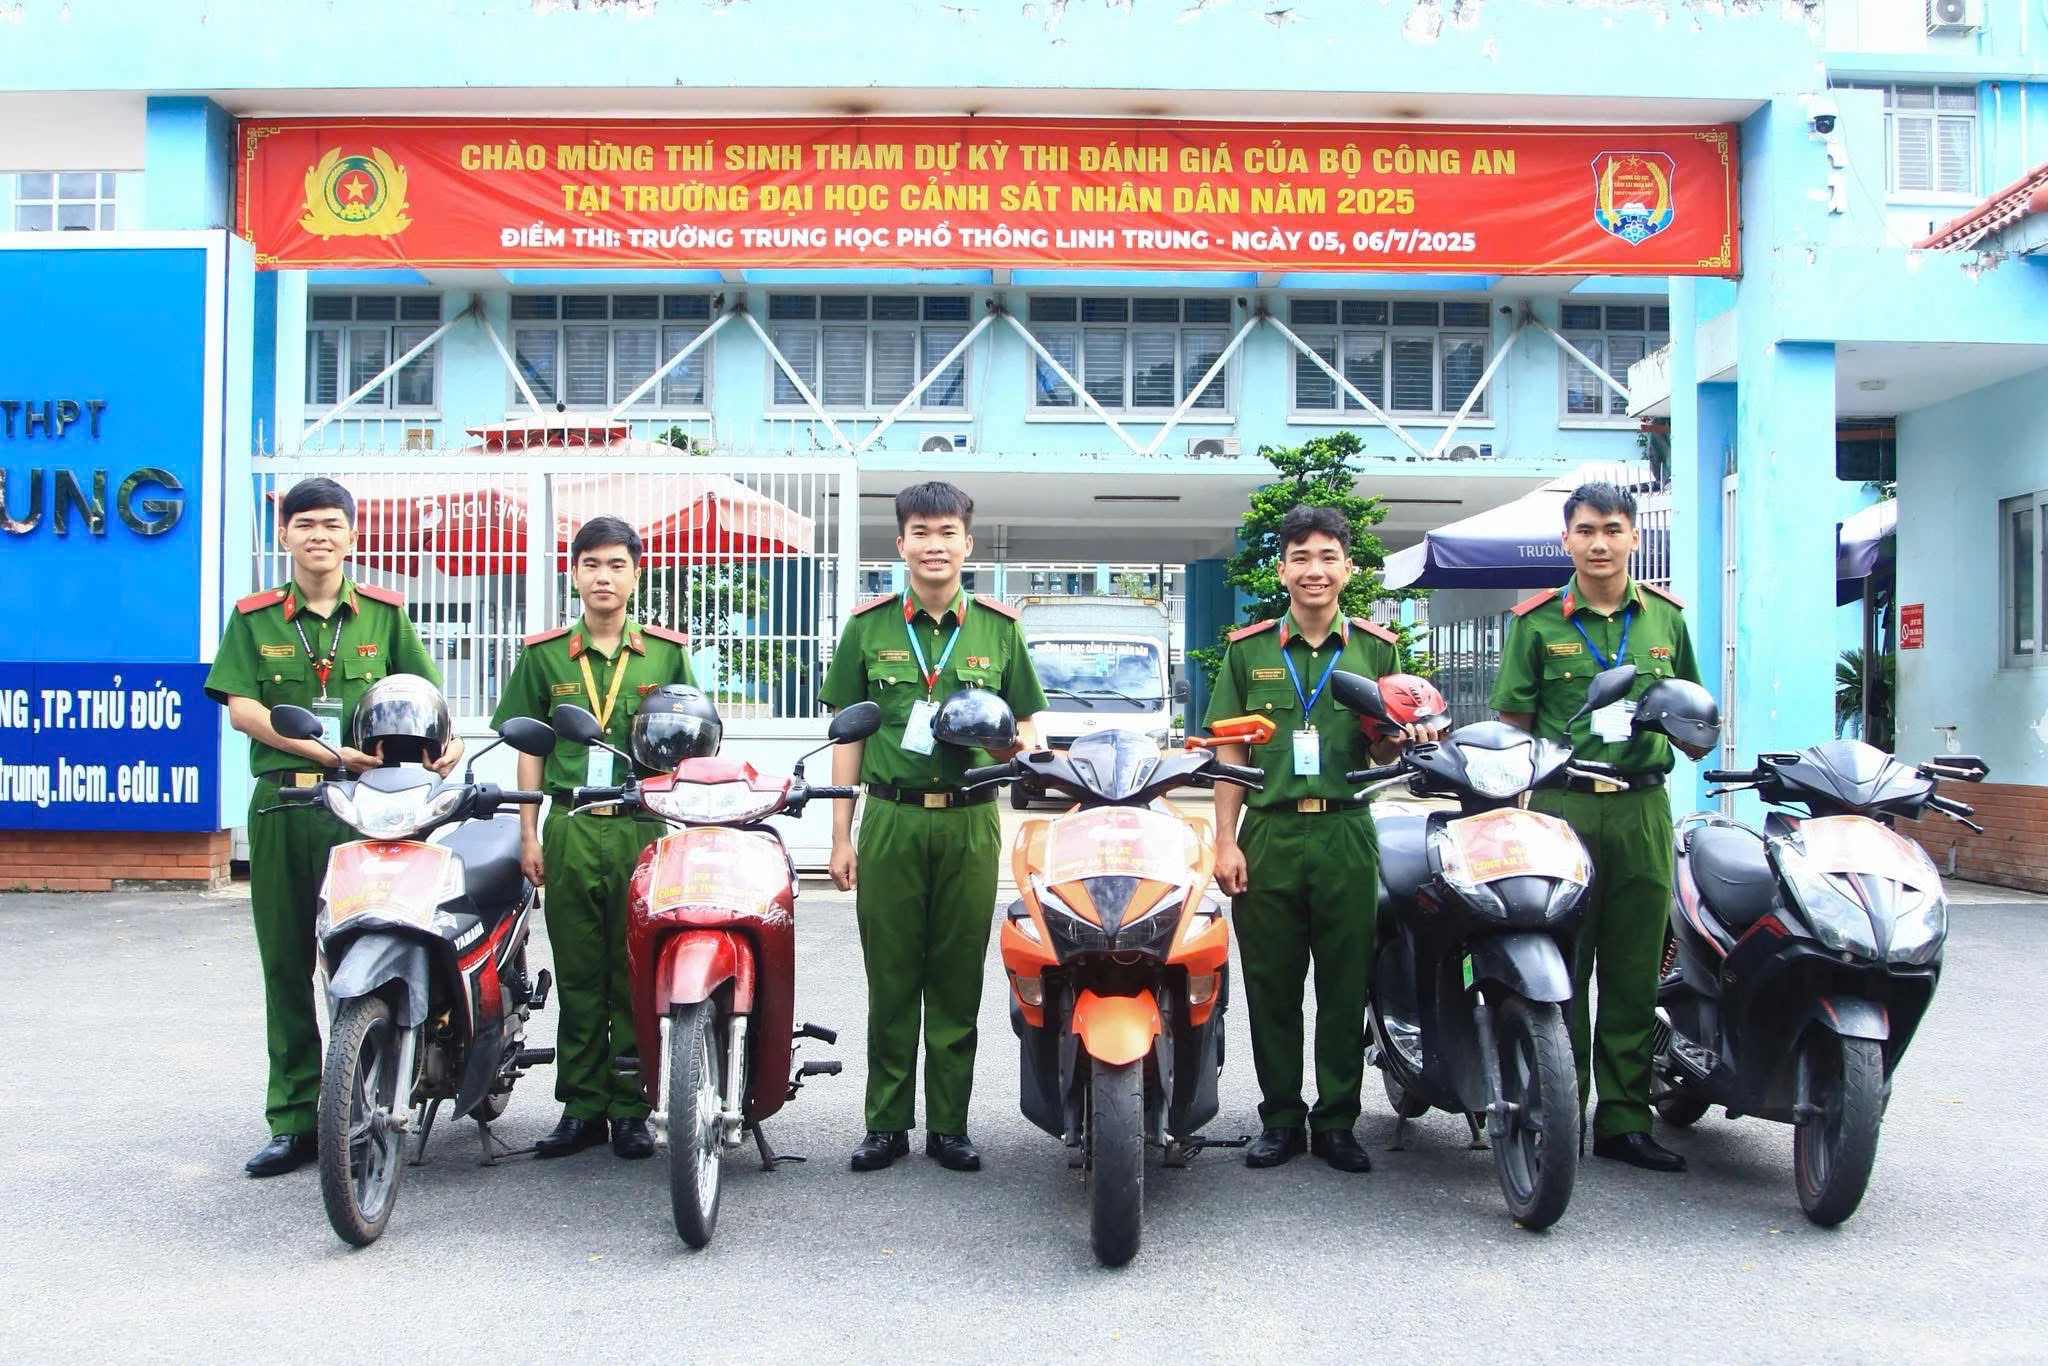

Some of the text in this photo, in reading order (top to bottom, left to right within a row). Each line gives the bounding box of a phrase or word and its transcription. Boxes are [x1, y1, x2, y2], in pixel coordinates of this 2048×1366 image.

[461, 139, 1515, 178] CHÀO MỪNG THÍ SINH THAM DỰ KỲ THI ĐÁNH GIÁ CỦA BỘ CÔNG AN
[561, 176, 1415, 217] TẠI TRƯỜNG ĐẠI HỌC CẢNH SÁT NHÂN DÂN NĂM 2025
[500, 221, 565, 247] ĐIỂM
[574, 228, 620, 248] THI:
[630, 224, 733, 248] TRƯỜNG
[740, 228, 827, 247] TRUNG
[835, 228, 889, 252] HỌC
[897, 221, 951, 247] PHỔ
[958, 224, 1048, 248] THÔNG
[1056, 229, 1114, 248] LINH
[1122, 229, 1208, 249] TRUNG
[1232, 227, 1302, 250] NGÀY
[1309, 232, 1345, 254] 05,
[1353, 229, 1475, 253] 06/7/2025
[1, 399, 106, 437] THPT
[131, 680, 182, 730] ĐỨC
